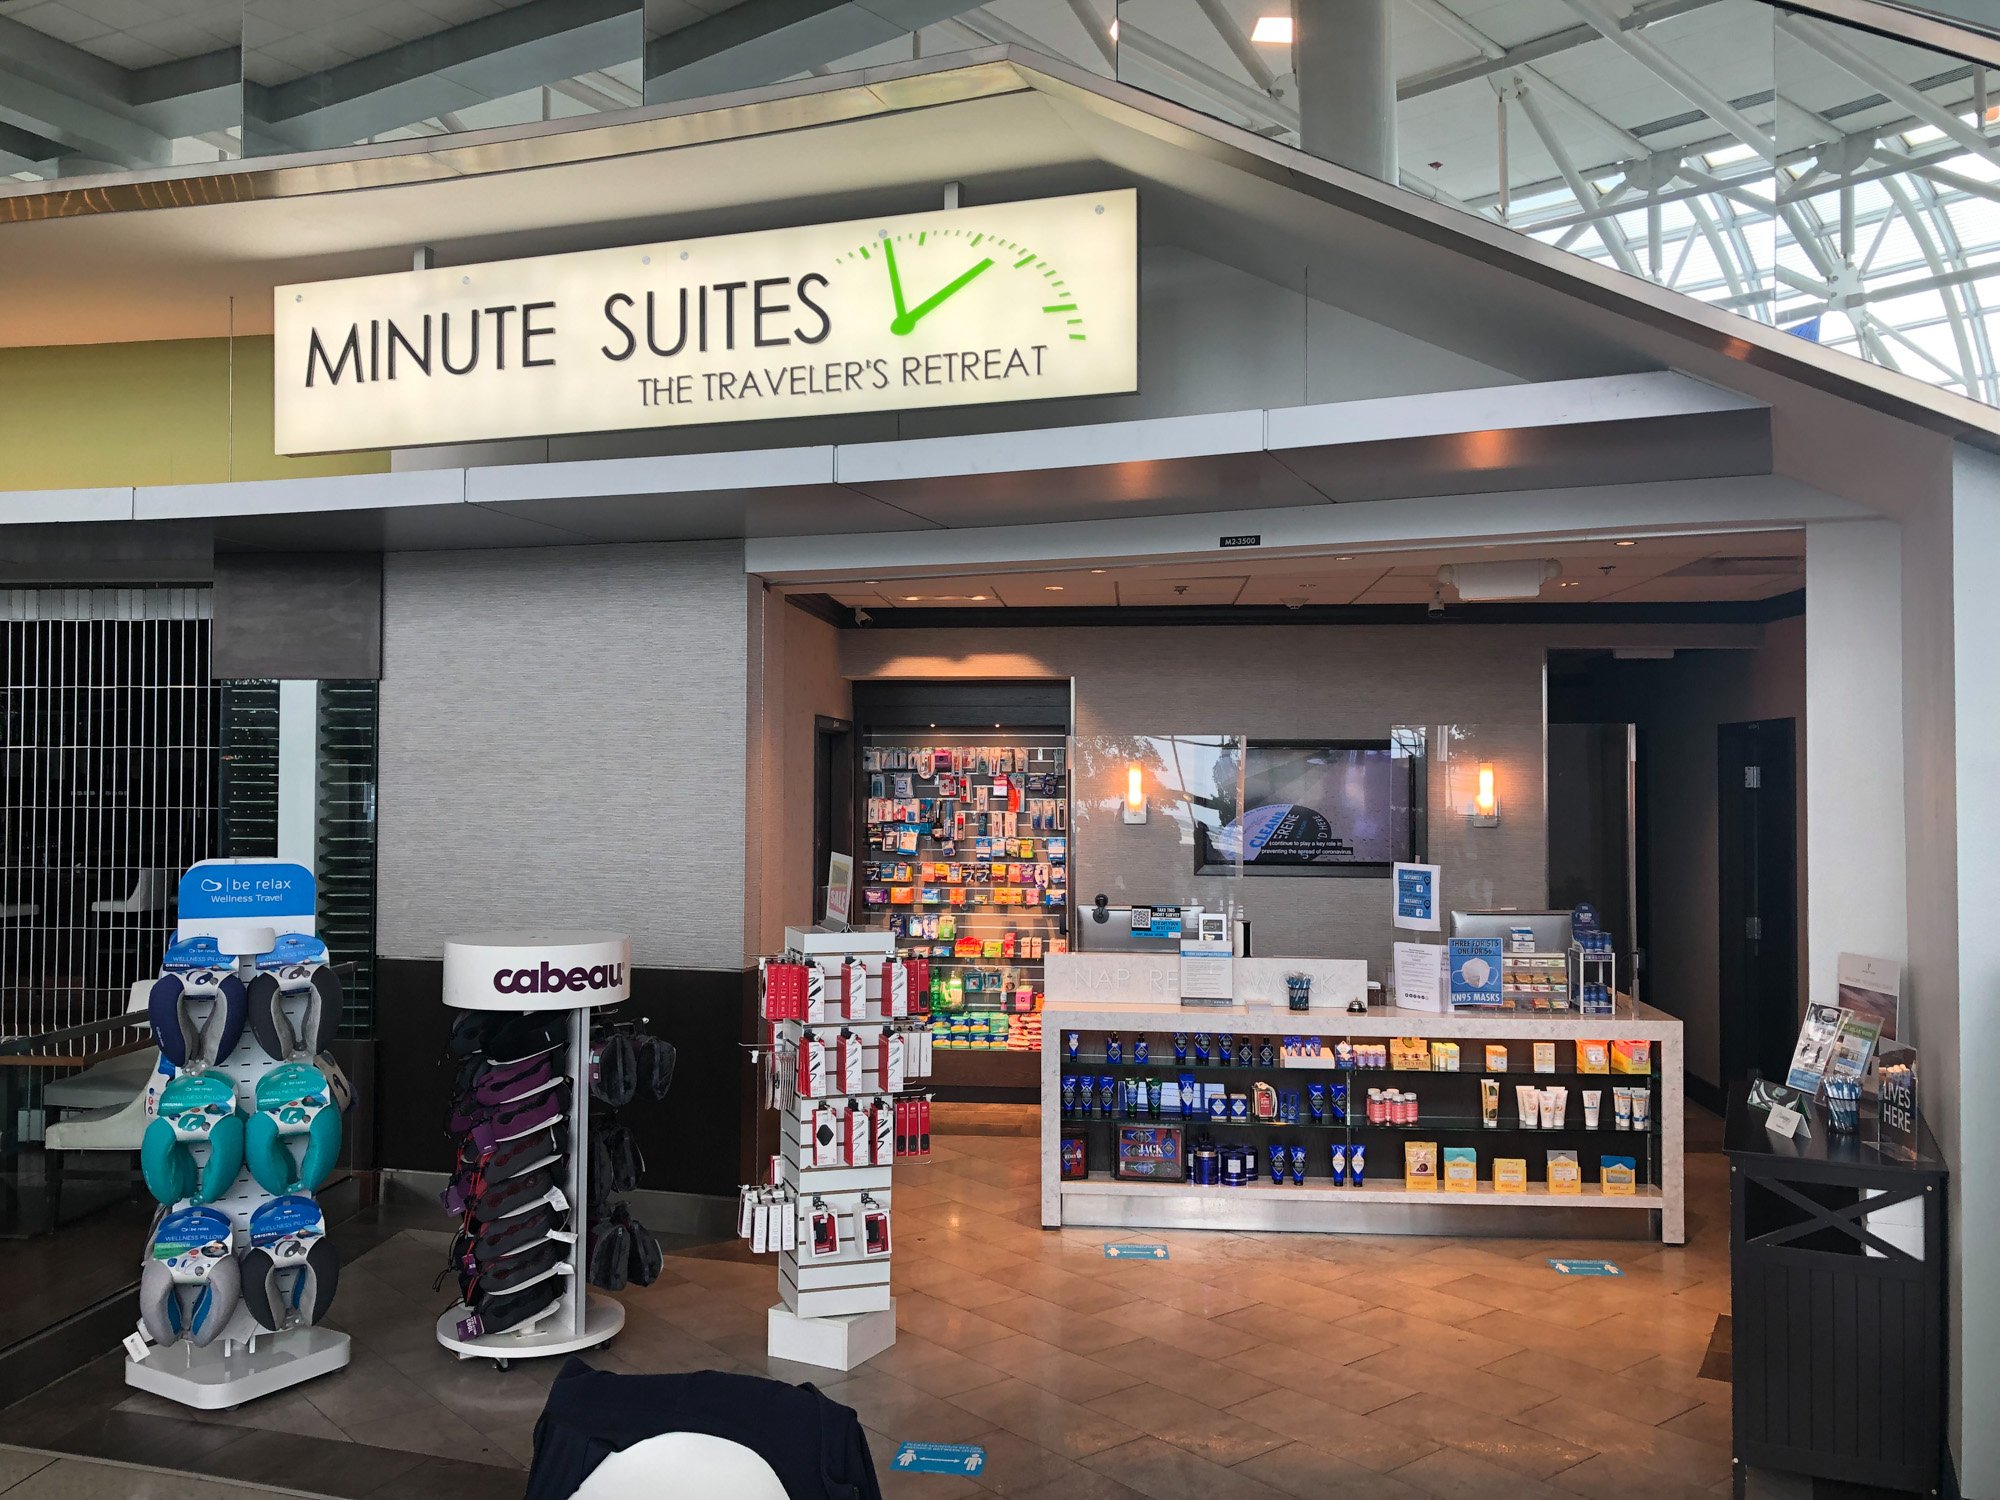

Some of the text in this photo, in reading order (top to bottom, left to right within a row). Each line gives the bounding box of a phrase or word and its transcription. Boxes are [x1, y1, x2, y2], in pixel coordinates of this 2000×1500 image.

[305, 272, 833, 388] MINUTE SUITES
[638, 345, 1049, 407] THE TRAVELER'S RETREAT
[1225, 537, 1256, 546] M2-3500
[233, 878, 291, 890] be relax
[211, 893, 283, 903] Wellness Travel
[493, 961, 623, 994] cabeau
[1075, 968, 1130, 990] NAP
[1452, 993, 1500, 1002] KN95 MASKS
[1883, 1080, 1910, 1109] LIVES
[1883, 1102, 1910, 1134] HERE
[1138, 1144, 1163, 1154] JACK
